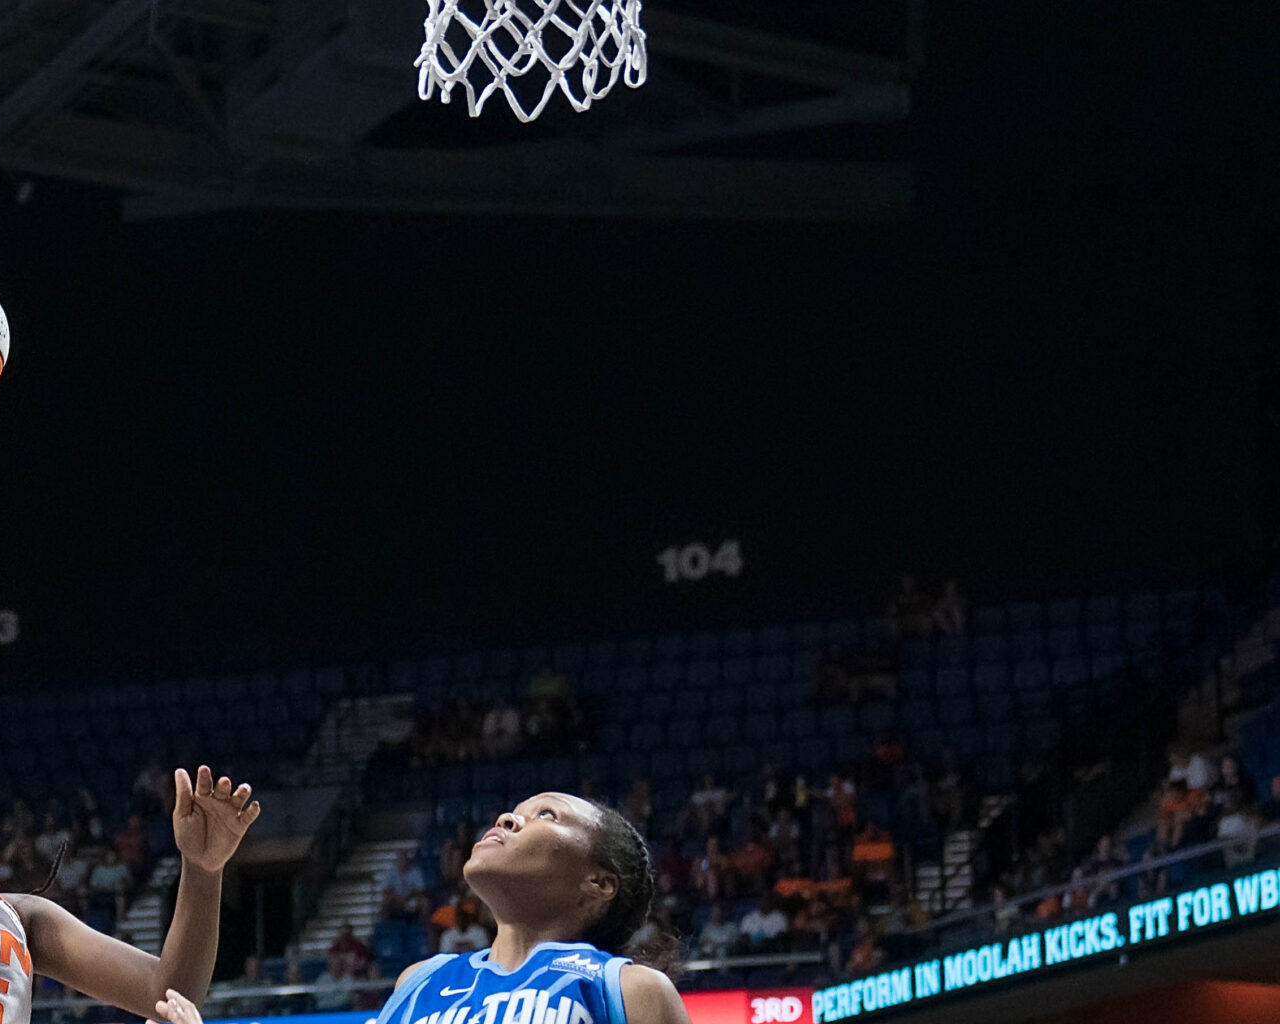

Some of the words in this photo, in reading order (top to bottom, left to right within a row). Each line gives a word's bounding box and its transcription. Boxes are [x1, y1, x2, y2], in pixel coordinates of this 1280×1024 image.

[656, 541, 742, 582] 104
[812, 966, 914, 1024] PERFORM
[915, 959, 941, 999] IN
[943, 932, 1042, 992] MOOLAH
[1044, 912, 1126, 965] KICKS.
[1128, 897, 1173, 944] FIT
[1176, 882, 1232, 931] FOR
[1233, 867, 1280, 916] WB
[750, 996, 803, 1024] 3RD
